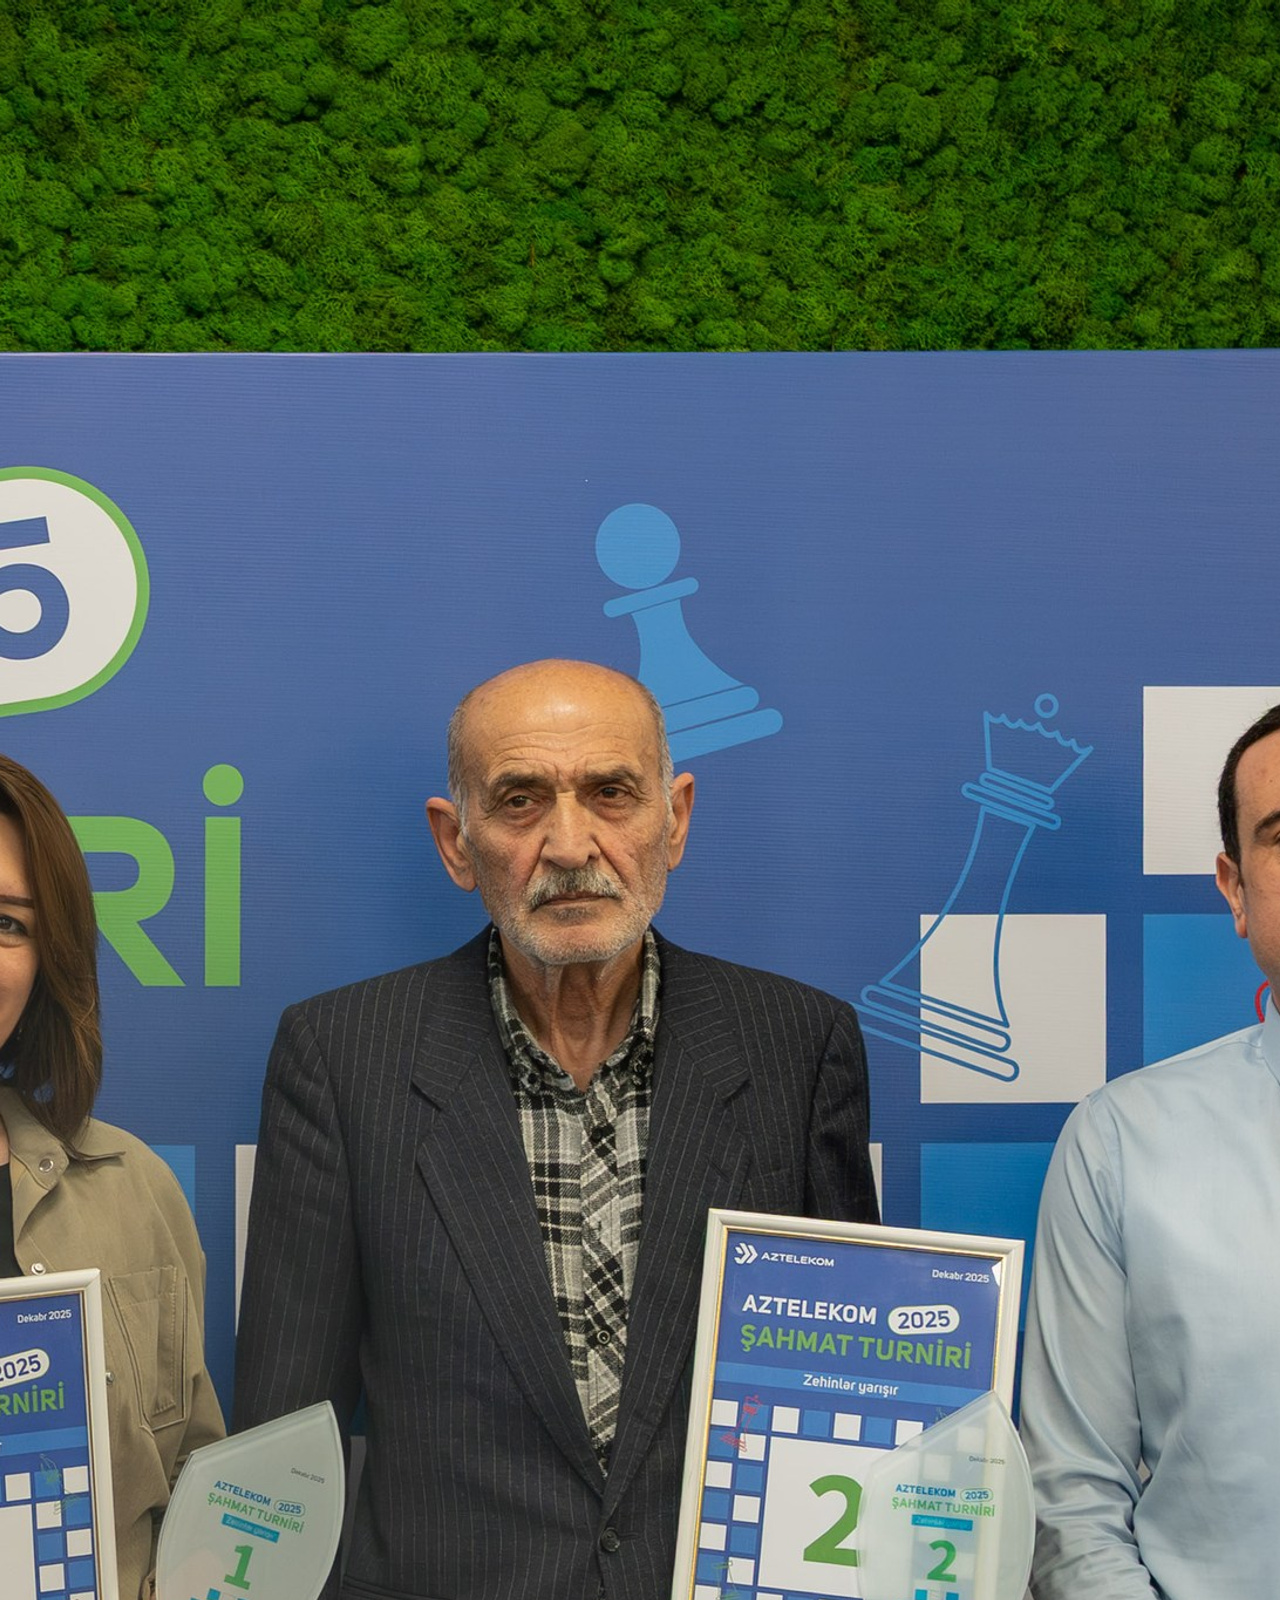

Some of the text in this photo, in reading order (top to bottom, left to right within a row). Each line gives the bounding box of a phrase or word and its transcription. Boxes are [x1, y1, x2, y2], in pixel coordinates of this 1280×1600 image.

[761, 1252, 835, 1267] AZTELEKOM
[931, 1269, 990, 1283] Dekabr 2025
[17, 1309, 72, 1324] Dekabr 2025
[742, 1294, 951, 1329] AZTELEKOM 2025
[740, 1324, 972, 1369] ŞAHMAT TURNİRİ
[858, 1381, 900, 1398] yarışır
[214, 1480, 301, 1514] AZTELEKOM 2025
[891, 1496, 995, 1517] ŞAHMAT TURNİRİ
[896, 1484, 989, 1500] AZTELEKOM 2025
[208, 1492, 256, 1517] ŞAHMAT
[257, 1508, 305, 1534] TURNİRİ
[802, 1474, 863, 1567] 2
[223, 1544, 254, 1590] 1
[926, 1539, 957, 1583] 2
